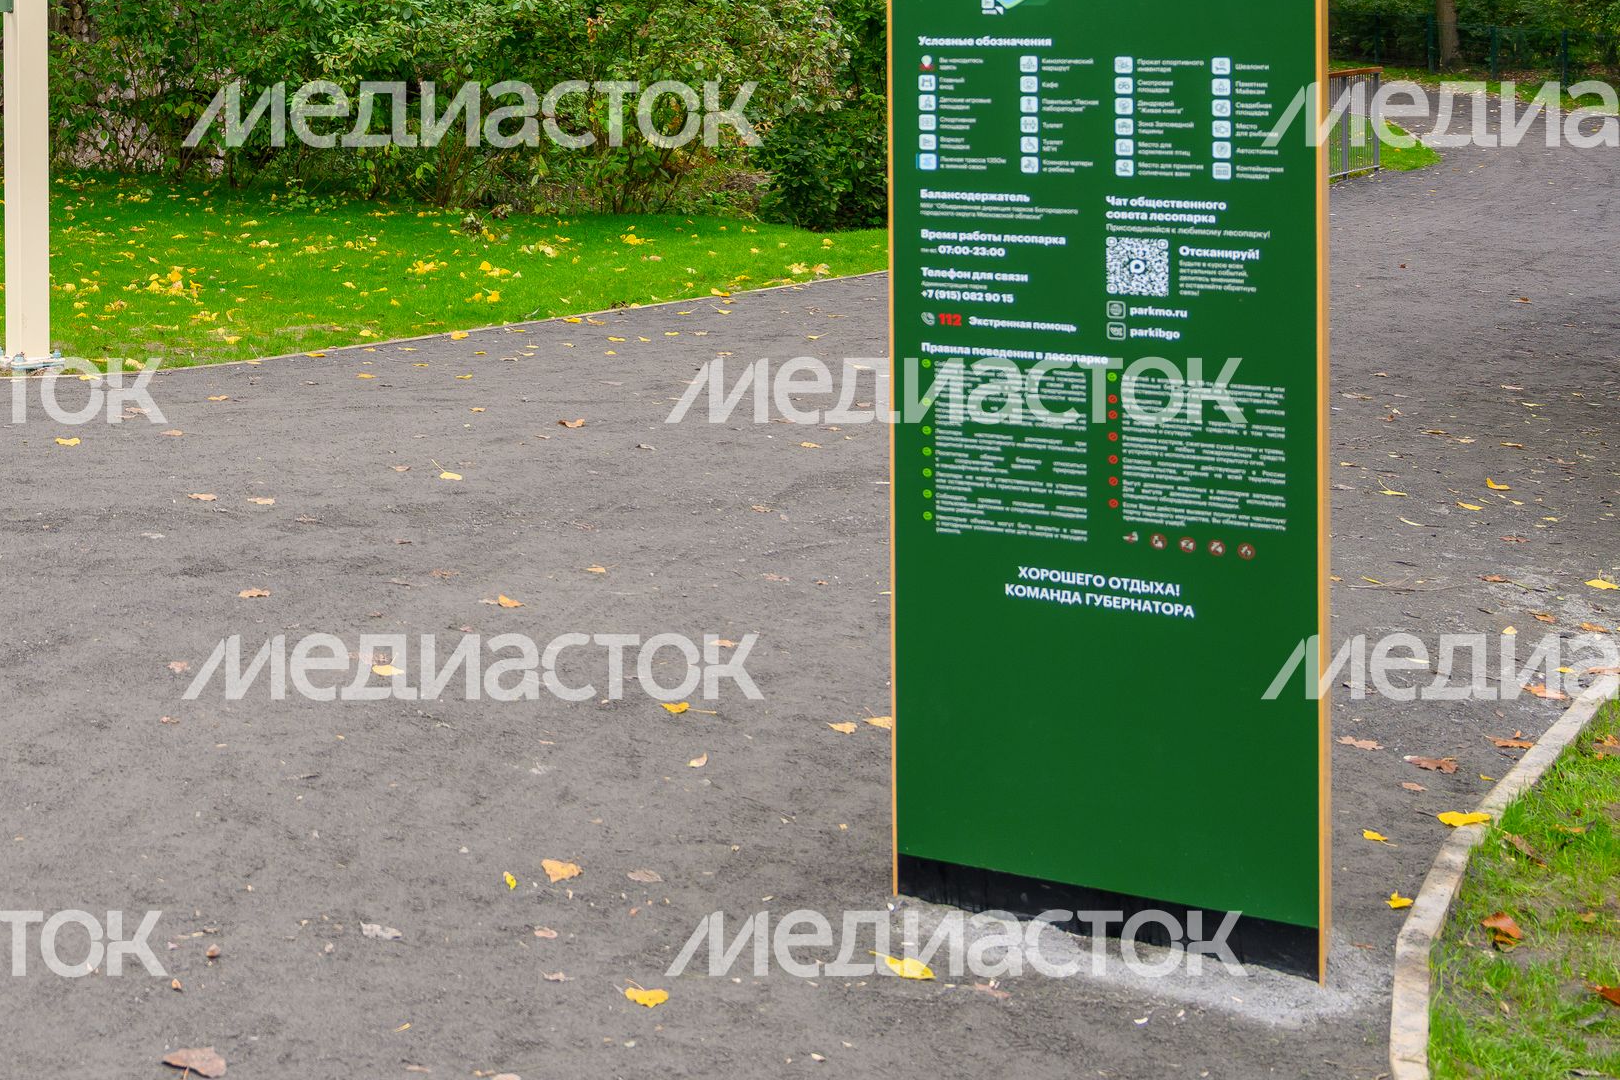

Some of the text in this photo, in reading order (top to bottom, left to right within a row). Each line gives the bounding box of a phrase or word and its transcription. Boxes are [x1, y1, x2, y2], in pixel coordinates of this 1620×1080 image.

[918, 35, 1052, 47] Условные обозначения
[920, 189, 1030, 203] Балансодержатель
[1105, 195, 1228, 210] Чат общественного
[1105, 211, 1216, 224] совета лесопарка
[920, 229, 1066, 246] Время работы лесопарка
[1106, 223, 1170, 234] Присоединяйся
[1179, 227, 1221, 237] любимому
[1223, 230, 1271, 239] лесопарку!
[938, 244, 1006, 257] 07:00-23:00
[1179, 245, 1260, 260] Отсканируй!
[920, 267, 1028, 282] Телефон для связи
[921, 290, 934, 300] +7
[935, 289, 962, 302] (915)
[985, 293, 1001, 303] 90
[1002, 294, 1014, 303] 15
[1130, 305, 1188, 319] parkmo.ru
[938, 313, 1077, 333] 112 Экстренная помощь
[1130, 327, 1180, 341] parkibgo
[921, 342, 1109, 365] Правила поведения в лесопарке
[1018, 565, 1180, 597] ХОРОШЕГО ОТДЫХА!
[1004, 583, 1195, 619] КОМАНДА ГУБЕРНАТОРА
